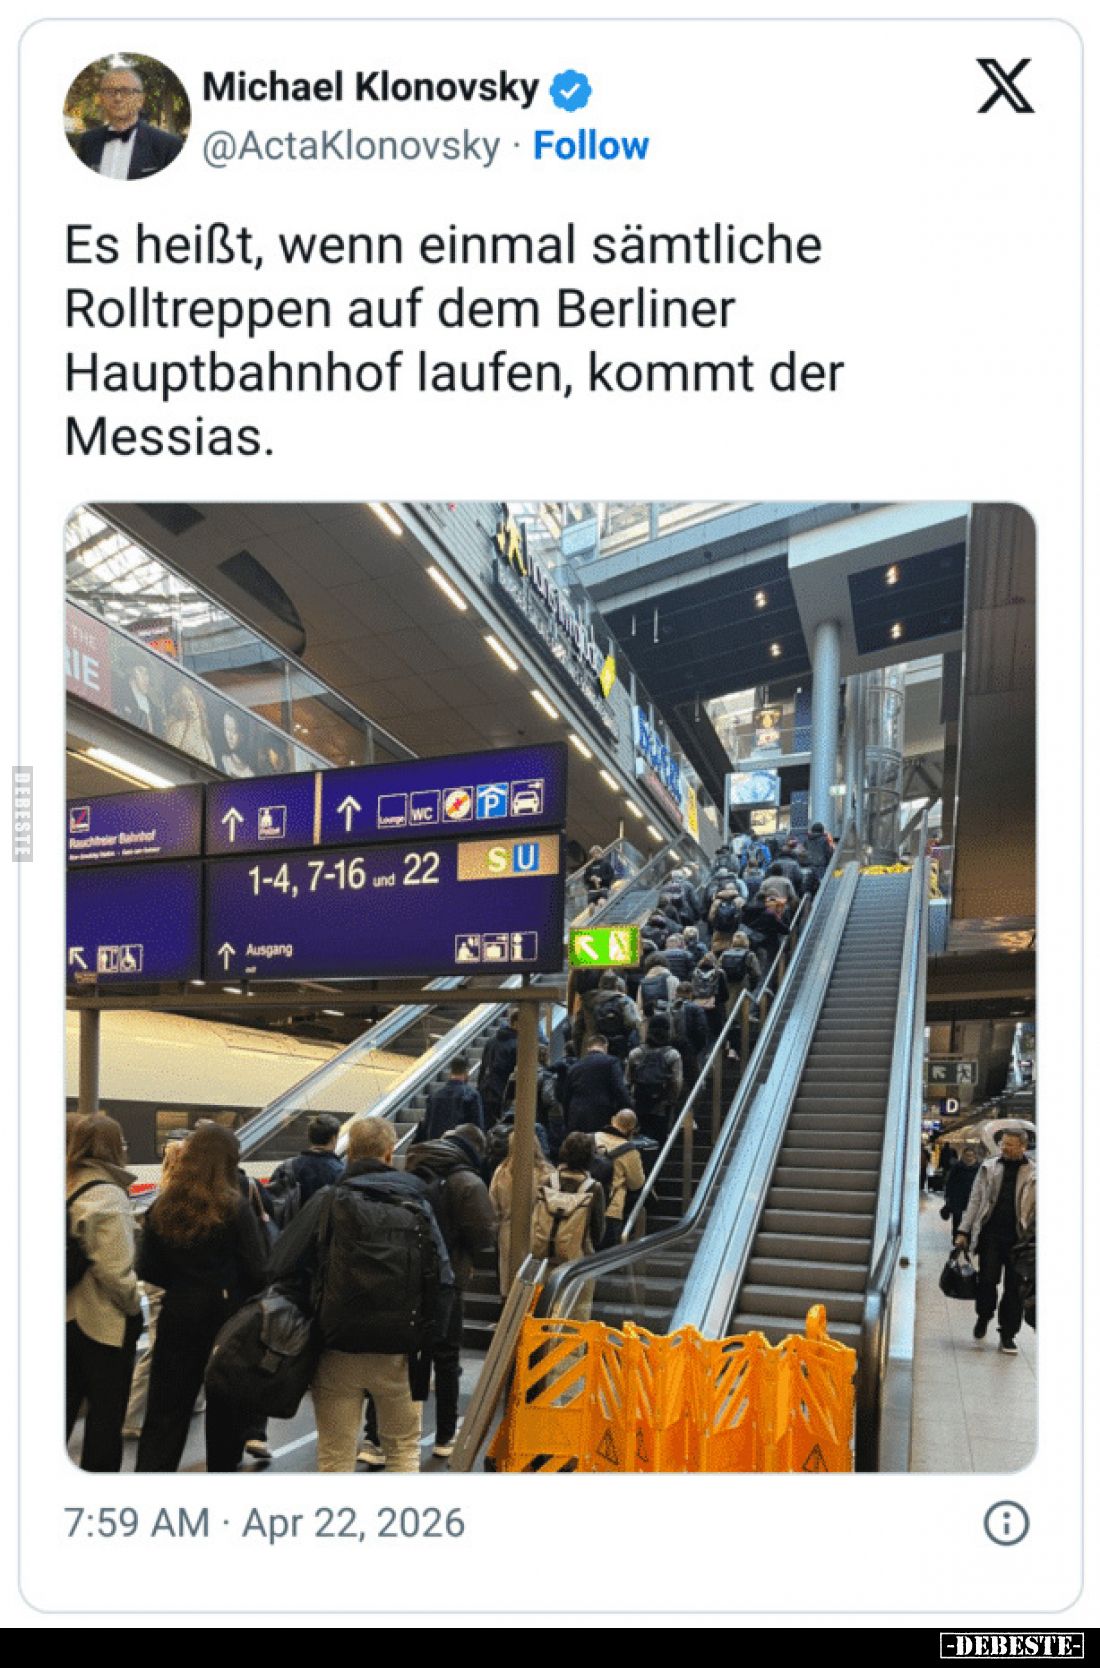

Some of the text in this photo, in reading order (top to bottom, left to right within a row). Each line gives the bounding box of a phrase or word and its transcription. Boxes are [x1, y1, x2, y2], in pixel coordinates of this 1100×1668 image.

[411, 806, 434, 822] WC
[248, 851, 441, 899] 1-4, 7-16 und 22
[245, 943, 293, 958] Ausgang
